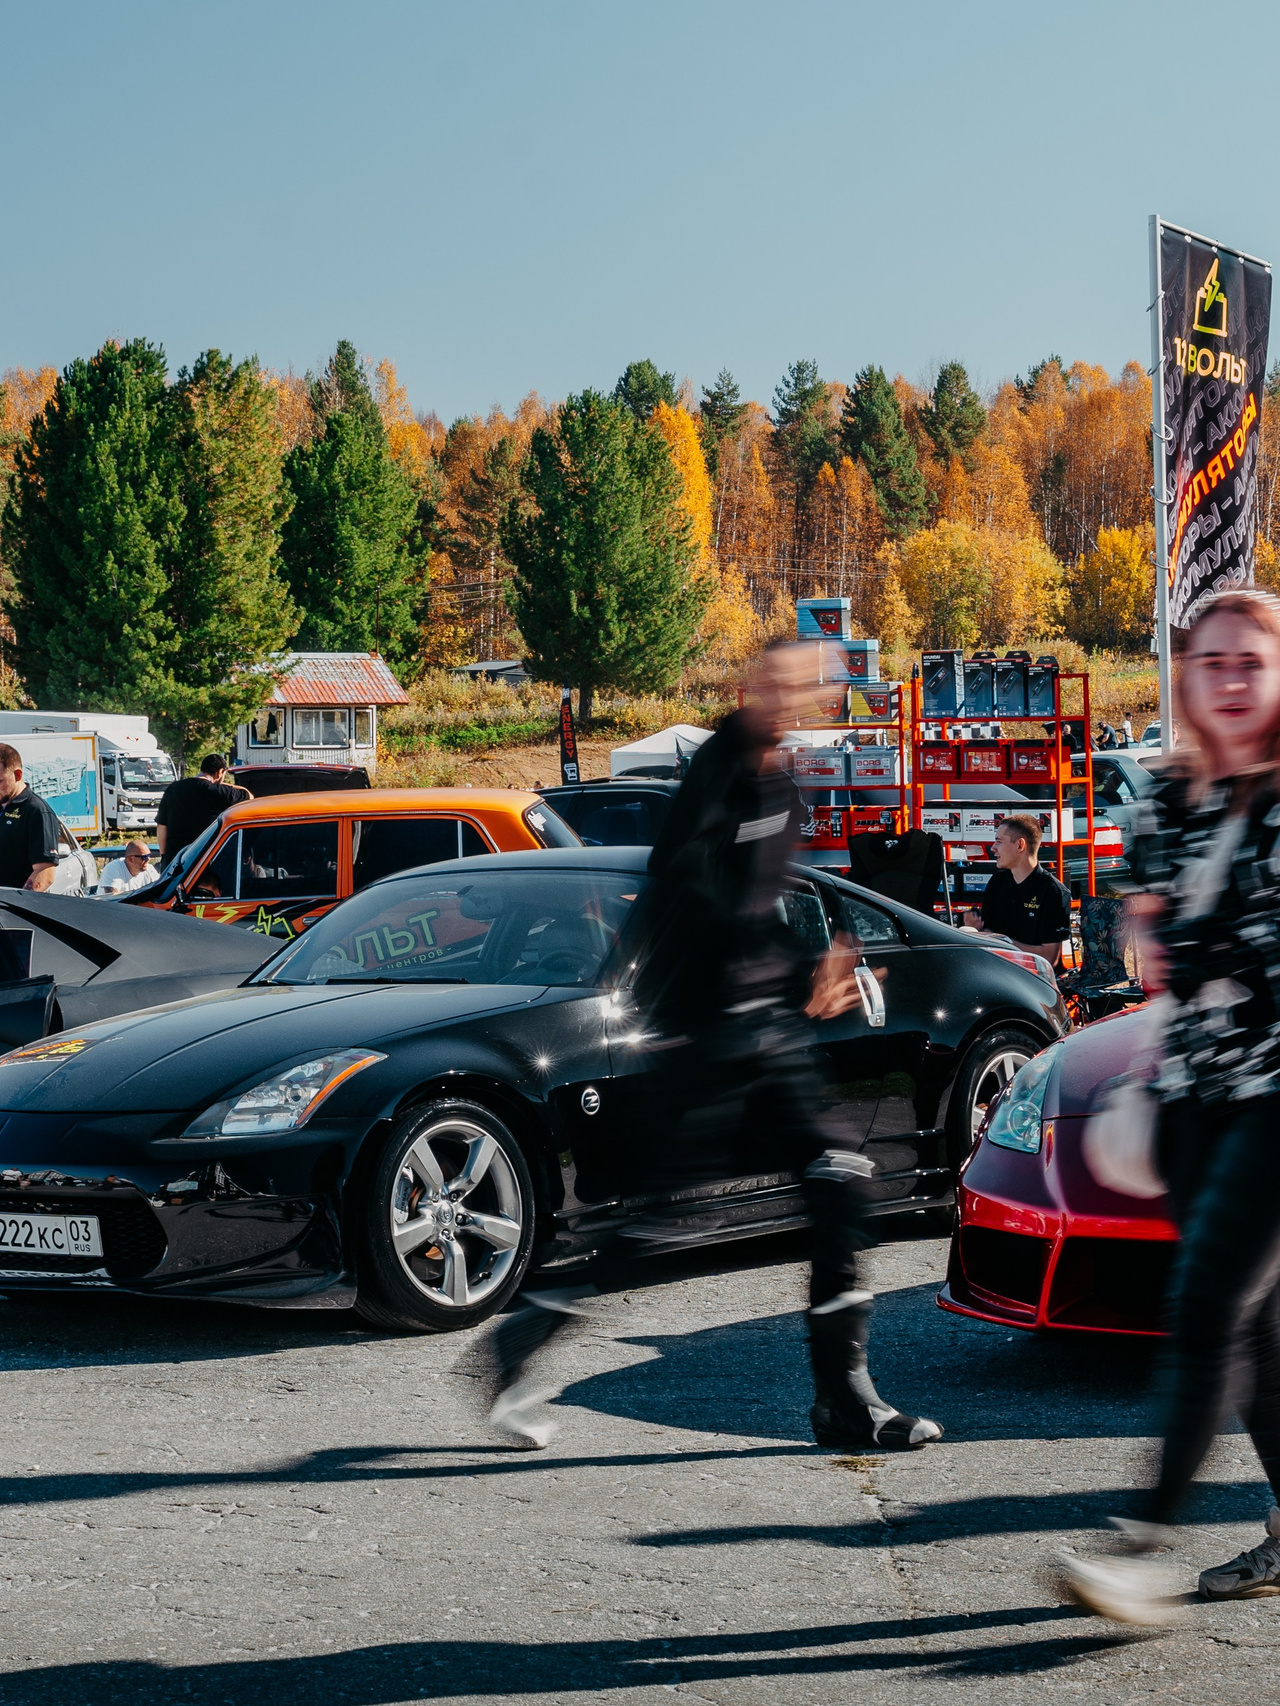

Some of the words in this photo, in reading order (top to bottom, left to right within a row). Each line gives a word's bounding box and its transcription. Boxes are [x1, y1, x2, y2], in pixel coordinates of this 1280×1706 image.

[1187, 343, 1247, 387] ВОЛЬТ
[561, 704, 574, 759] ENERGY
[796, 758, 826, 767] BORG
[69, 1220, 91, 1242] 03
[74, 1243, 91, 1253] RUS
